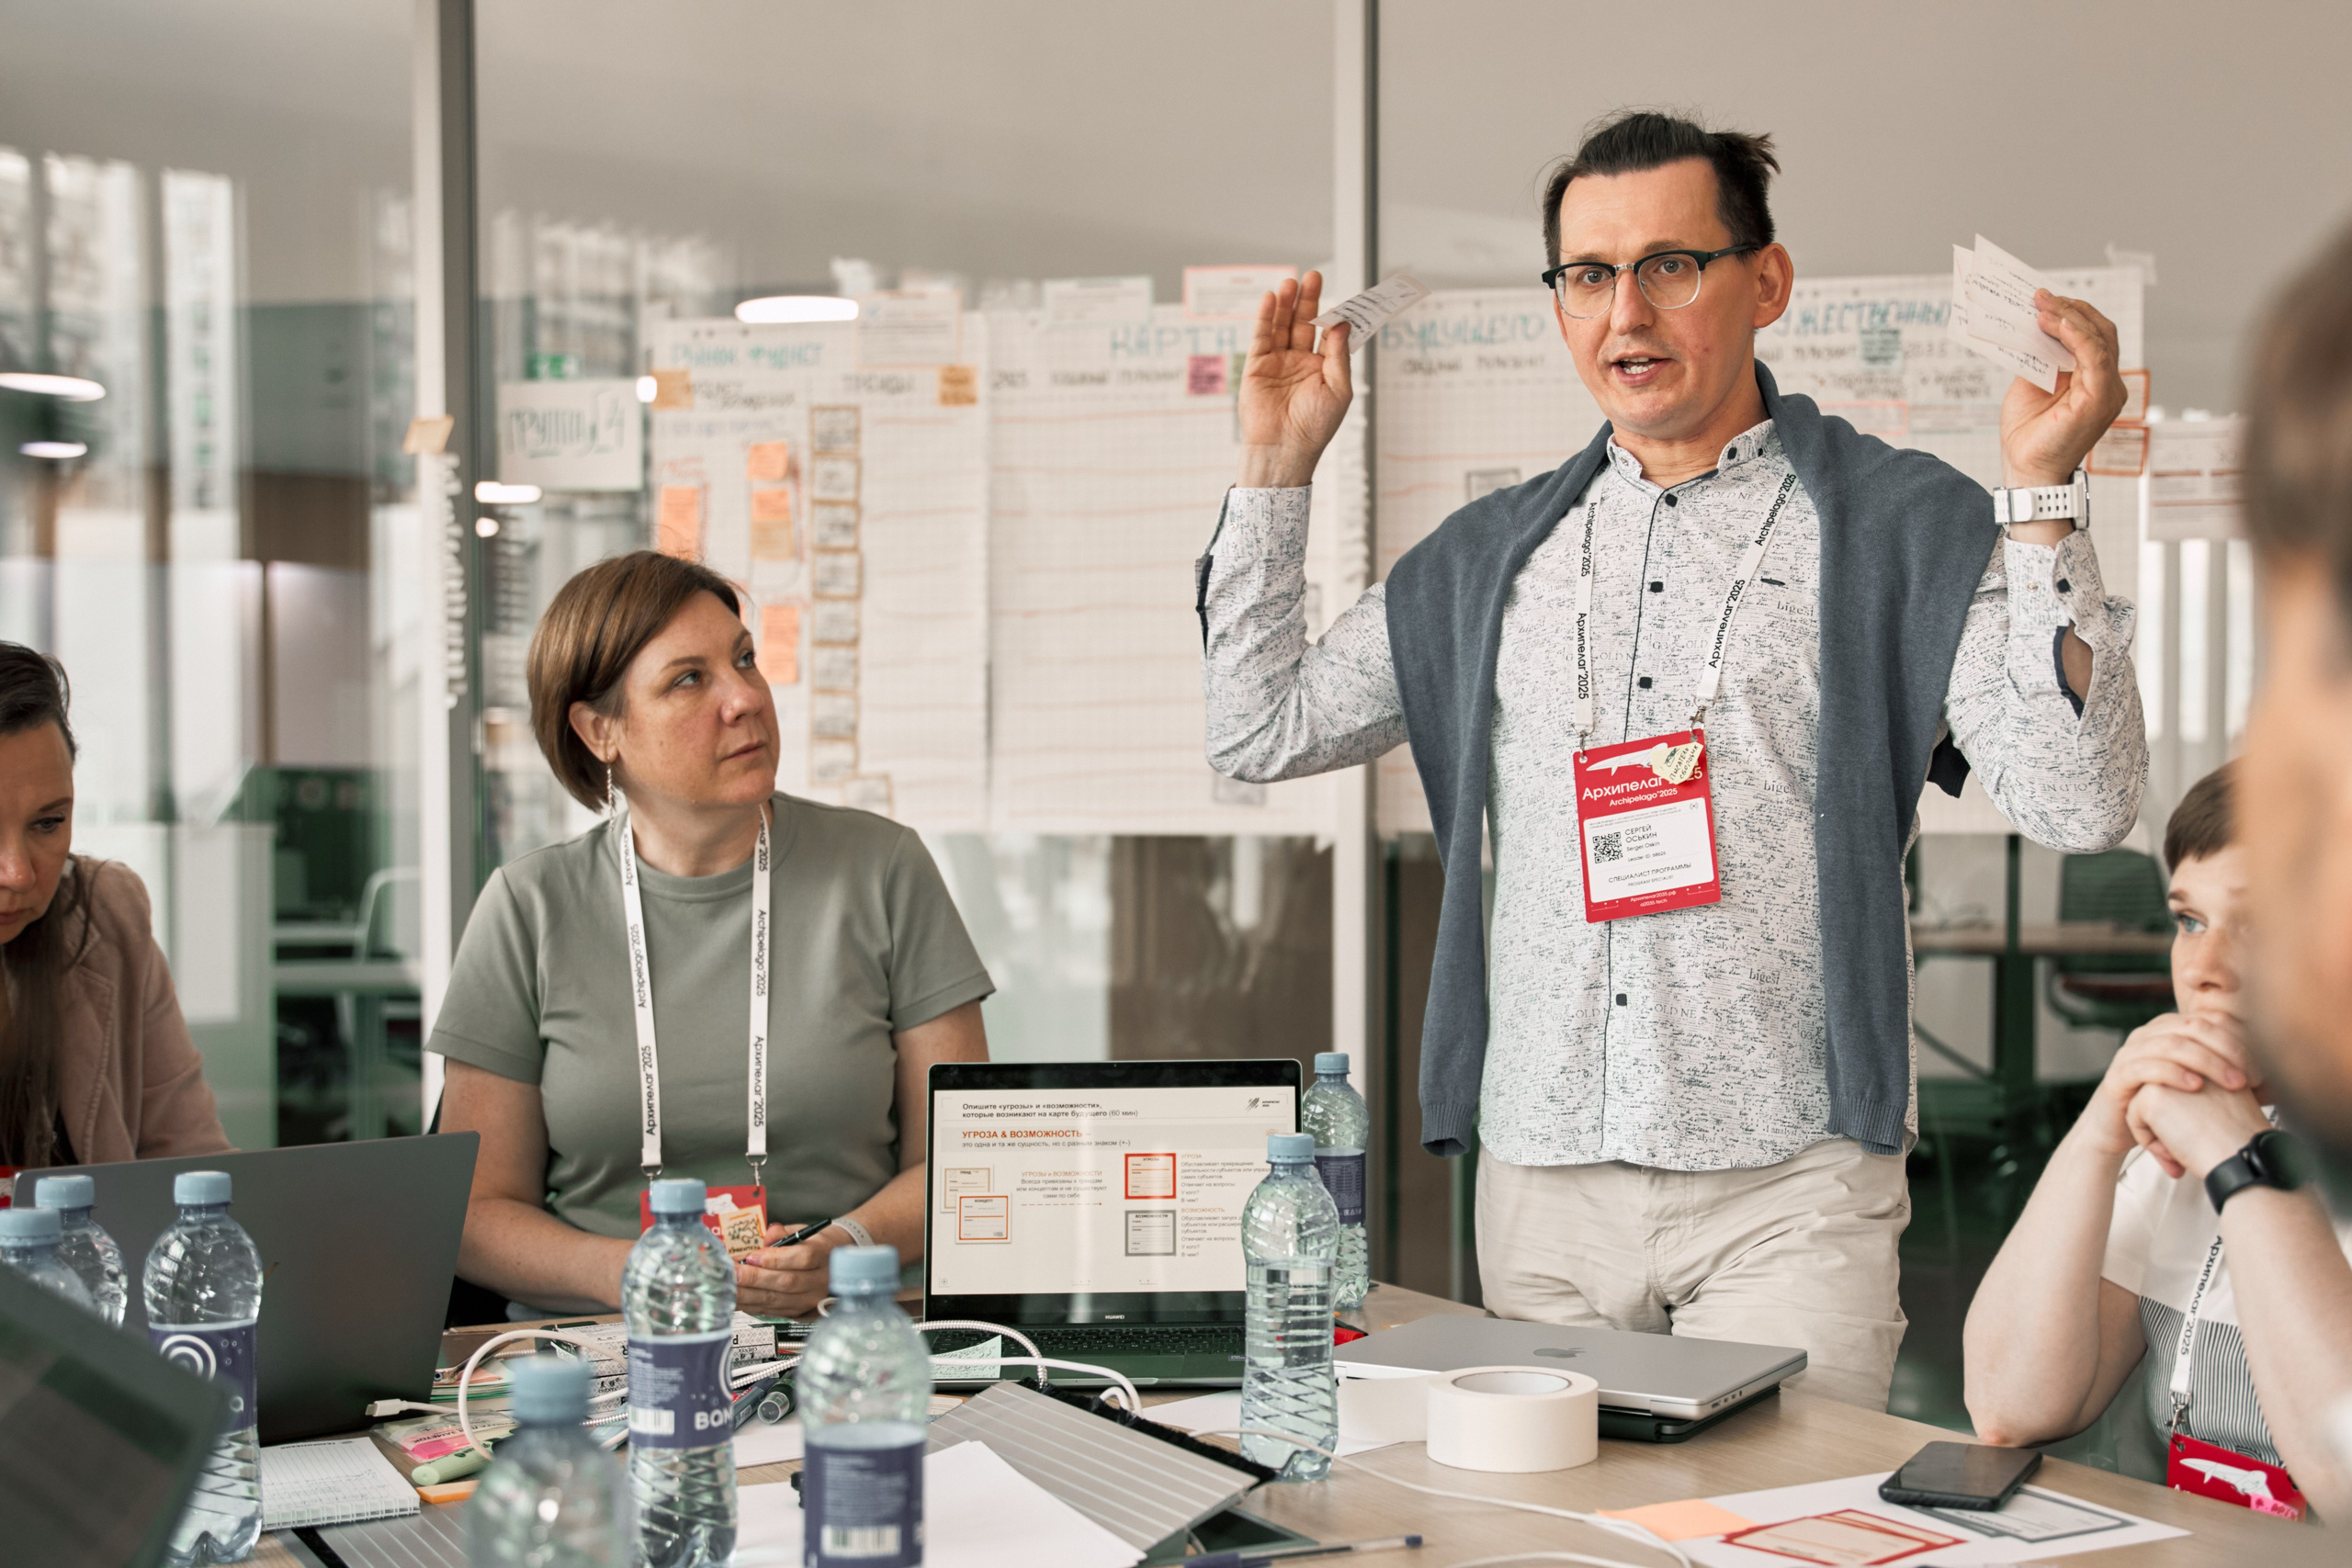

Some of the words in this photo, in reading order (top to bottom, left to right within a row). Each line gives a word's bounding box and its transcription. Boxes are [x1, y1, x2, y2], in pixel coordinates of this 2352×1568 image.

[1609, 787, 1679, 807] Archipelago'2025
[1624, 824, 1652, 836] СЕРГЕЙ
[1625, 831, 1657, 843] ОСЬКИН
[1608, 869, 1650, 884] СПЕЦИАЛИСТ
[1651, 862, 1692, 875] ПРОГРАММЫ
[1071, 1111, 1107, 1119] будущего
[1122, 1110, 1138, 1118] мин)
[962, 1130, 998, 1139] УГРОЗА
[1010, 1130, 1082, 1138] ВОЗМОЖНОСТЬ
